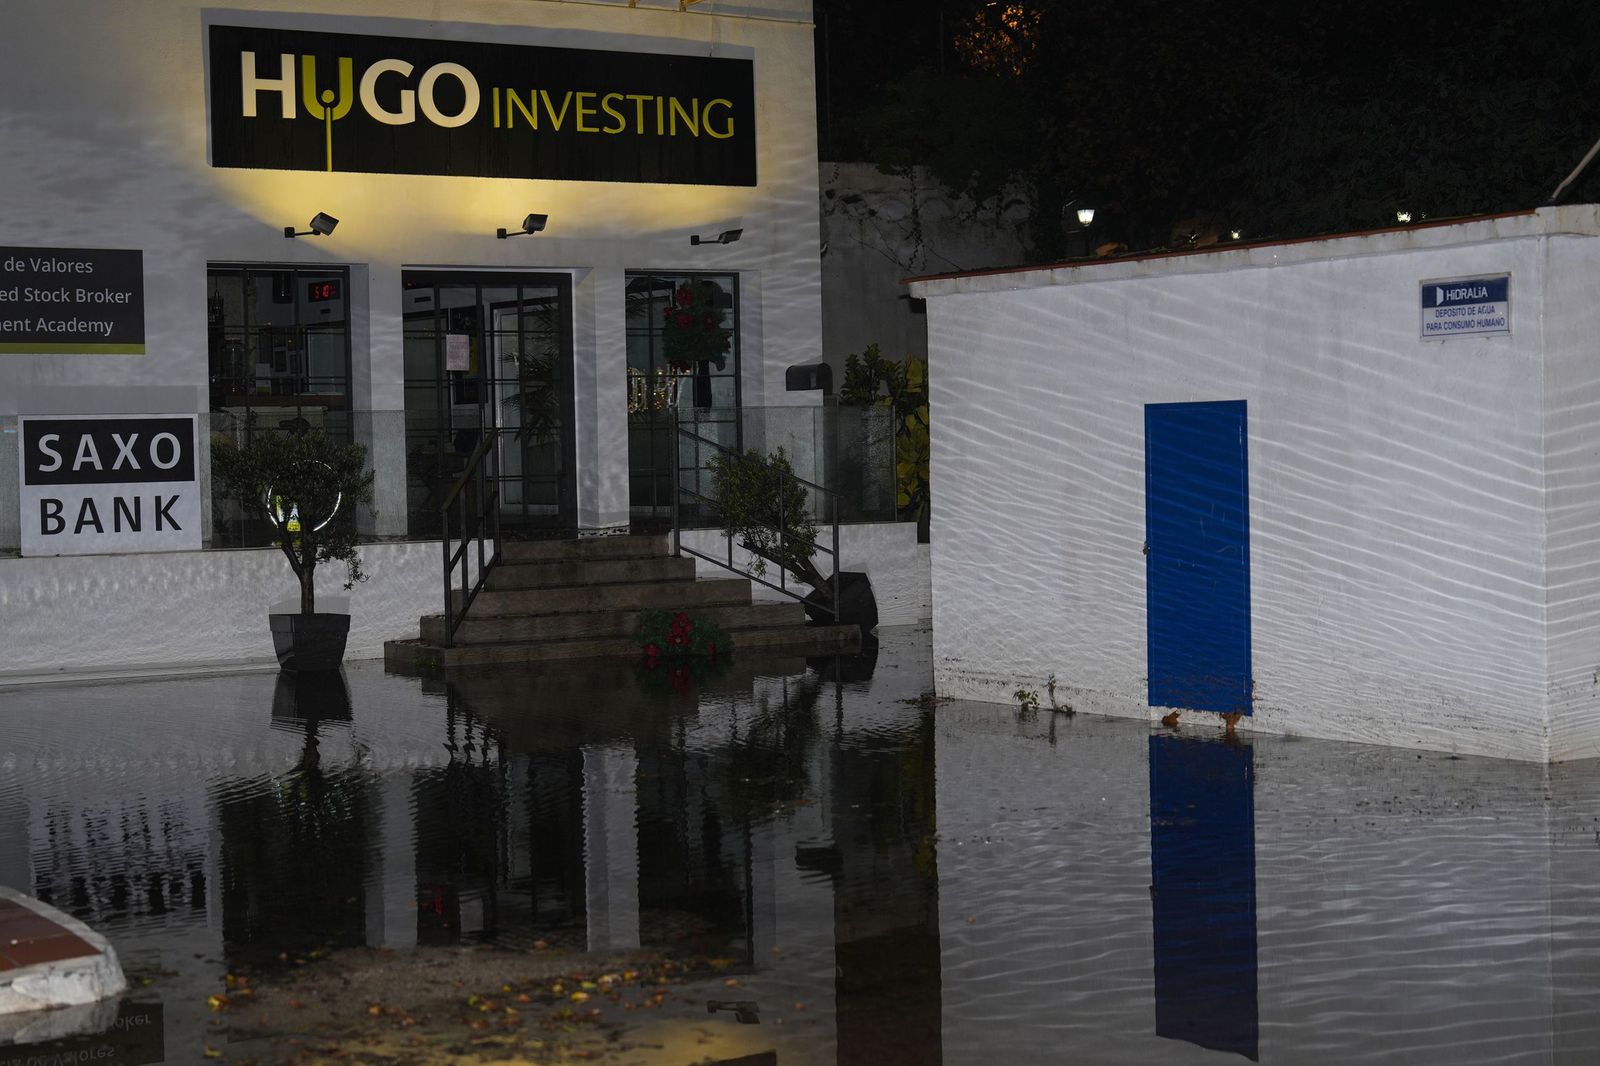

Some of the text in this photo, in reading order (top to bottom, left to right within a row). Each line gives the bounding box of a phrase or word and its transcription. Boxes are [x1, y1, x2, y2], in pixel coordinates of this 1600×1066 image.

[241, 51, 735, 139] HUGO INVESTING
[4, 257, 94, 273] de Valores
[24, 288, 71, 303] Stock
[76, 288, 132, 303] Broker
[1467, 306, 1476, 316] DE
[0, 317, 114, 337] ent Academy
[1426, 317, 1505, 332] PARA CONSUMO HUMANO
[38, 432, 182, 473] SAXO
[40, 494, 182, 536] BANK
